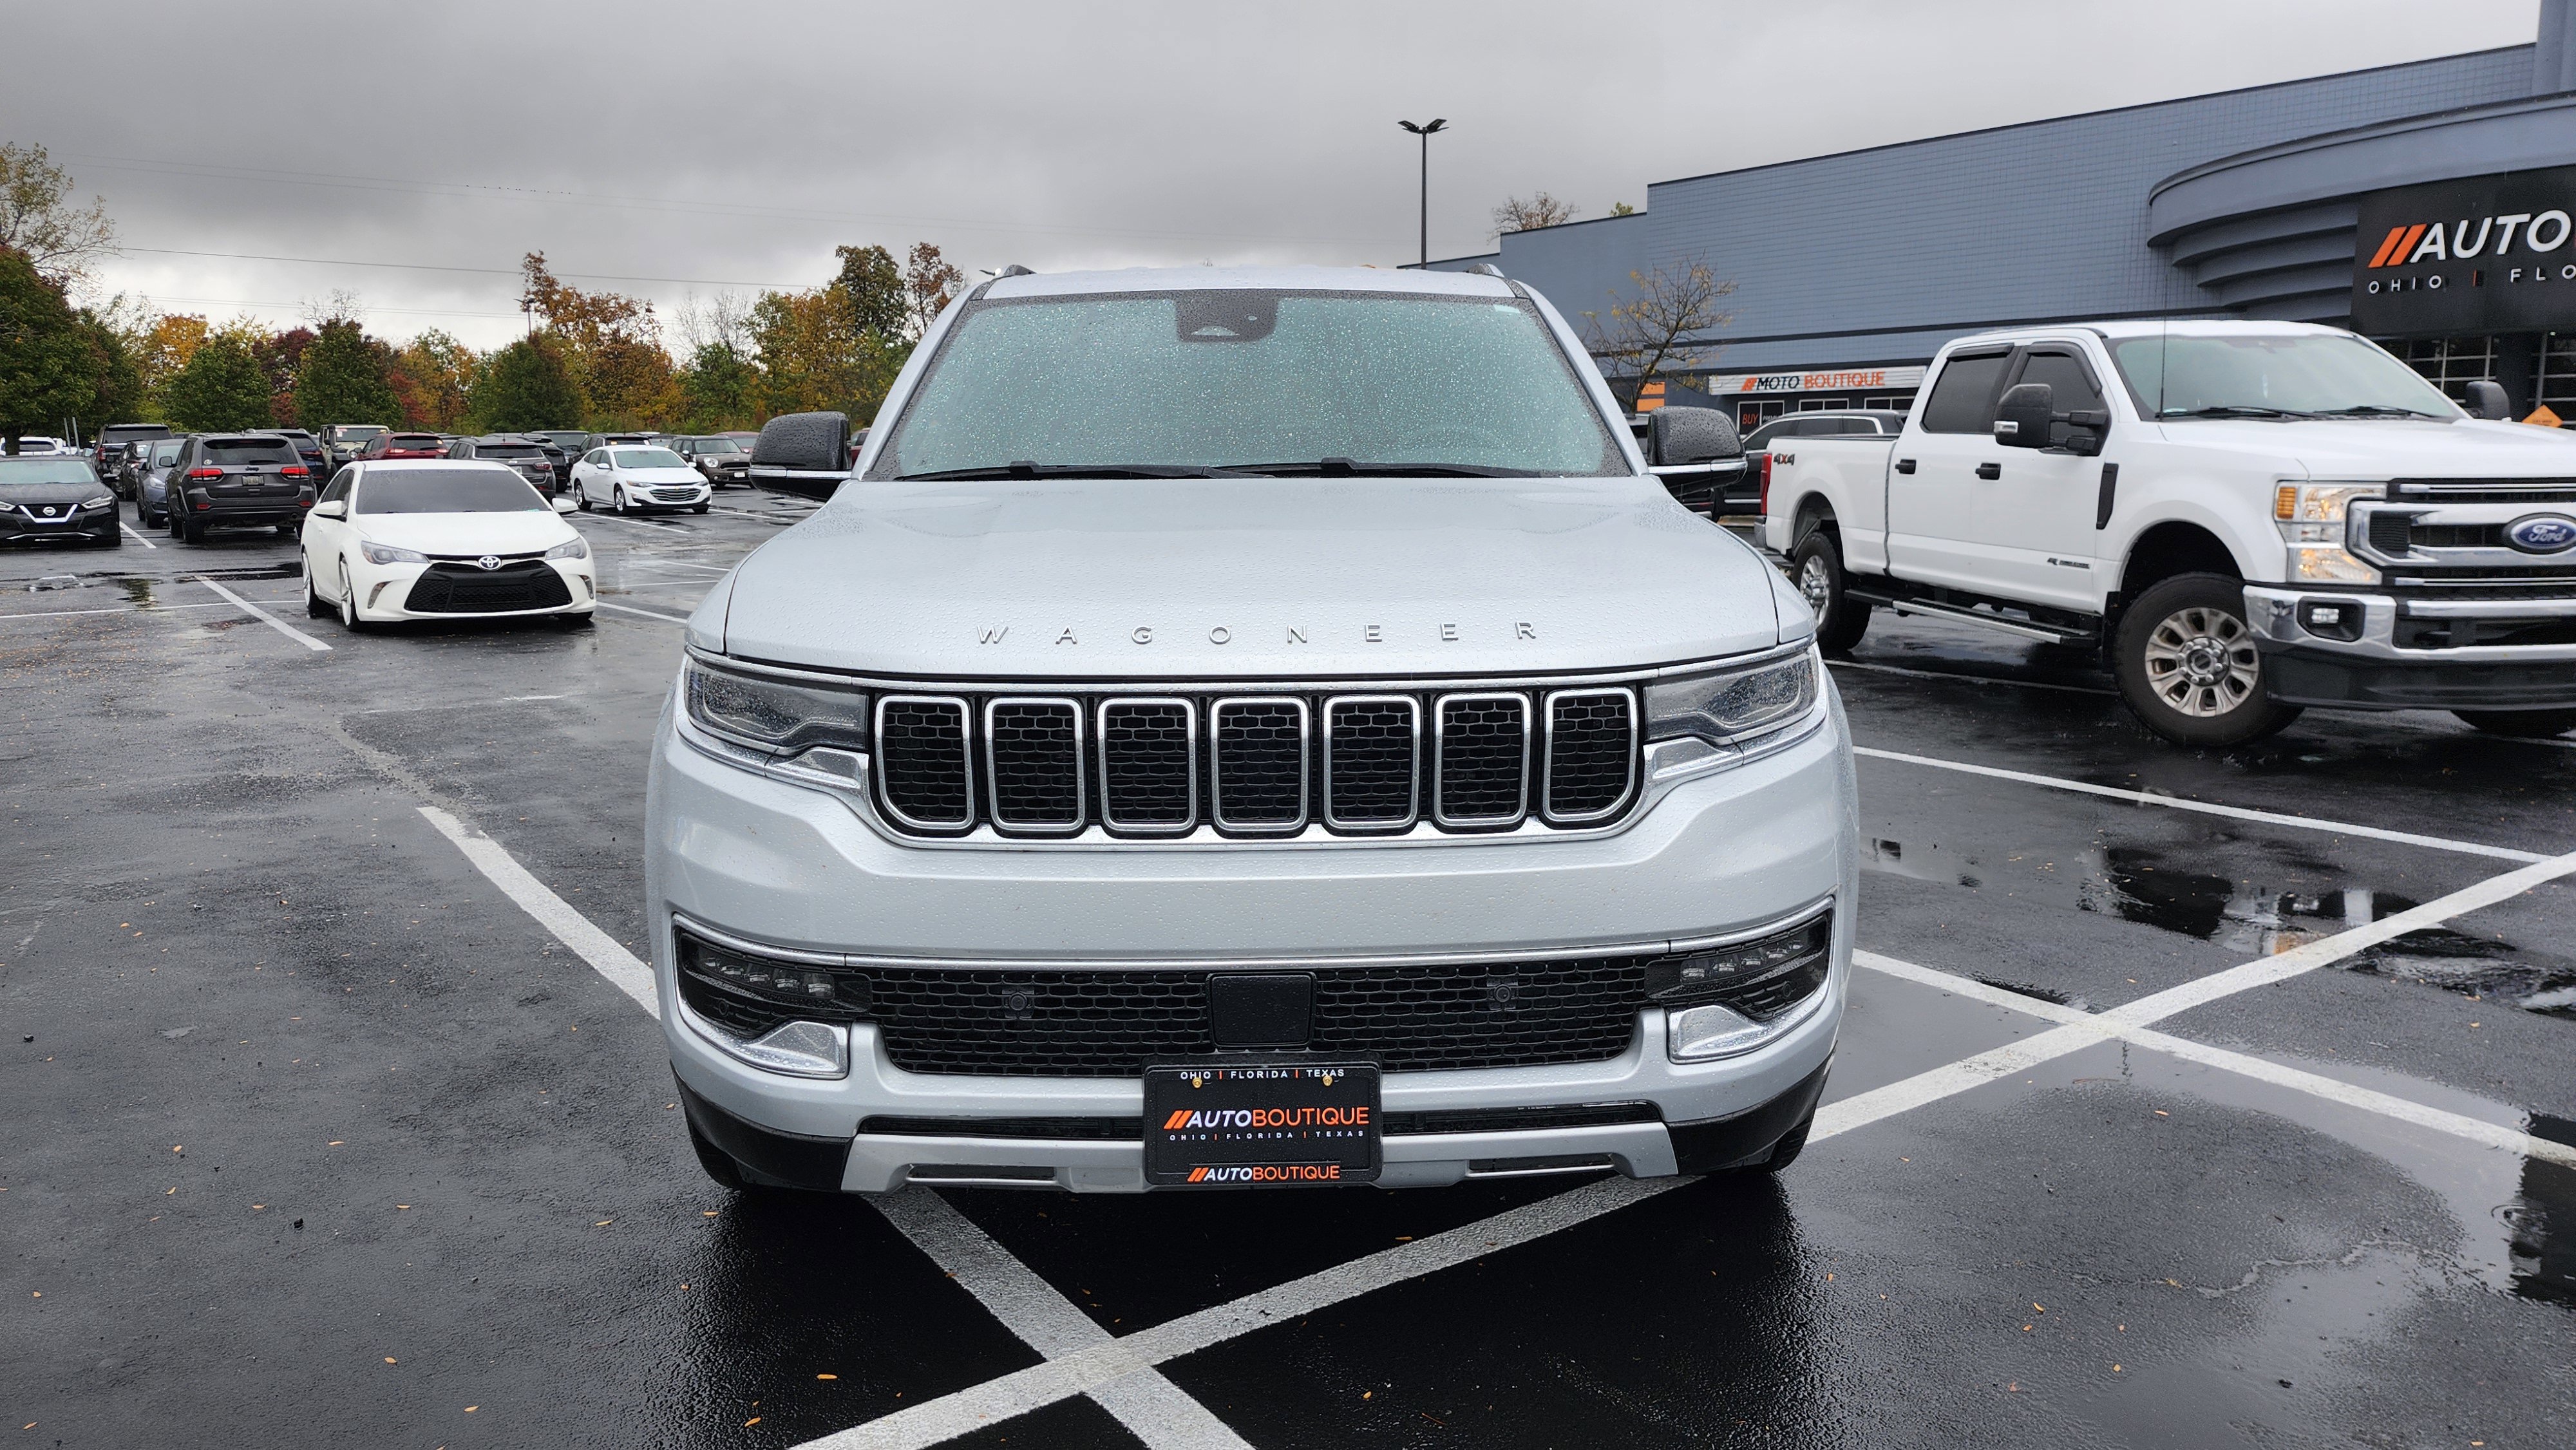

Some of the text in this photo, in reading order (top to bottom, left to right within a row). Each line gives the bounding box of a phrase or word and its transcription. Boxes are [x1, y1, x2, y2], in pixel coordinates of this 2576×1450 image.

[2409, 209, 2571, 263] AUTO
[2368, 264, 2576, 294] OHIO FLO
[1756, 371, 1886, 391] MOTO BOUTIQUE
[1742, 413, 1758, 424] BUY
[2528, 524, 2568, 542] Ford
[976, 620, 1537, 645] WAGONEER
[1180, 1068, 1345, 1080] OHIO FLORIDA TEXAS
[1226, 1131, 1293, 1140] FLORIDA
[1315, 1130, 1364, 1138] TEXAS
